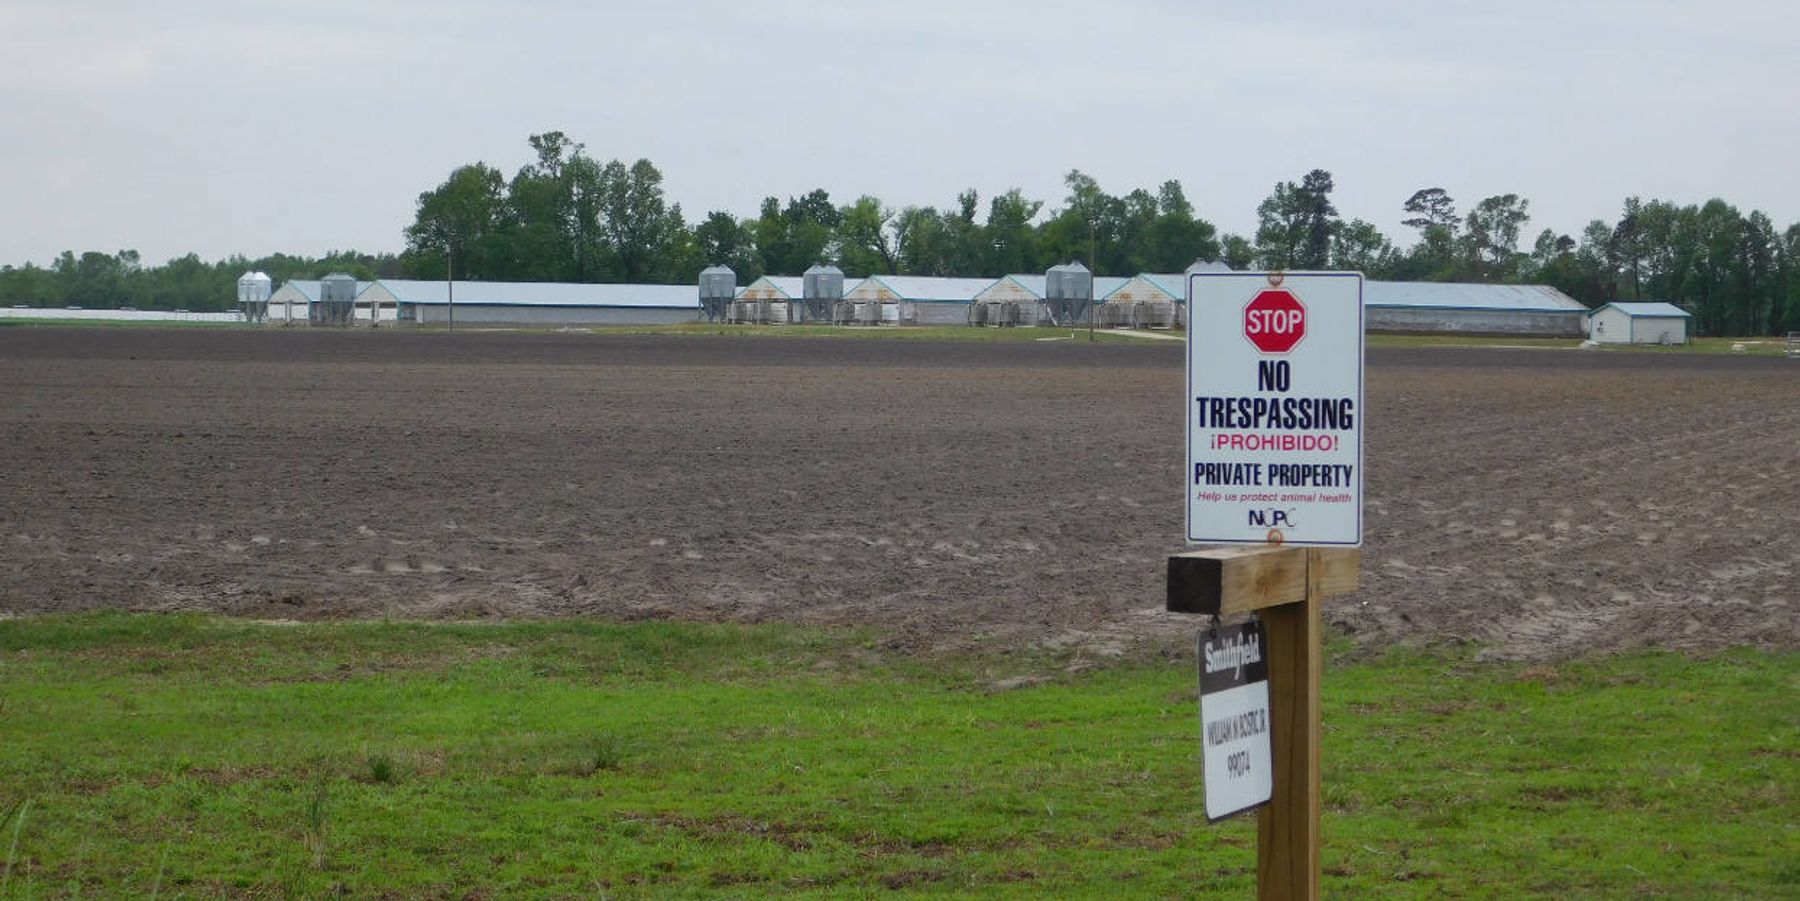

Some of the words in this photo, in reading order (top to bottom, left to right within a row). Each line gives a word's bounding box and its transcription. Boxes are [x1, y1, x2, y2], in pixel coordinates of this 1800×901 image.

[1247, 309, 1303, 334] STOP
[1258, 360, 1291, 392] NO
[1196, 397, 1354, 430] TRESPASSING
[1210, 434, 1339, 451] ¡PROHIBIDO!
[1194, 463, 1262, 486] PRIVATE
[1268, 463, 1353, 488] PROPERTY
[1197, 491, 1222, 503] Help
[1224, 494, 1238, 502] us
[1239, 492, 1278, 504] protect
[1280, 493, 1316, 503] animal
[1318, 493, 1352, 503] health
[1205, 632, 1262, 680] Smithfield
